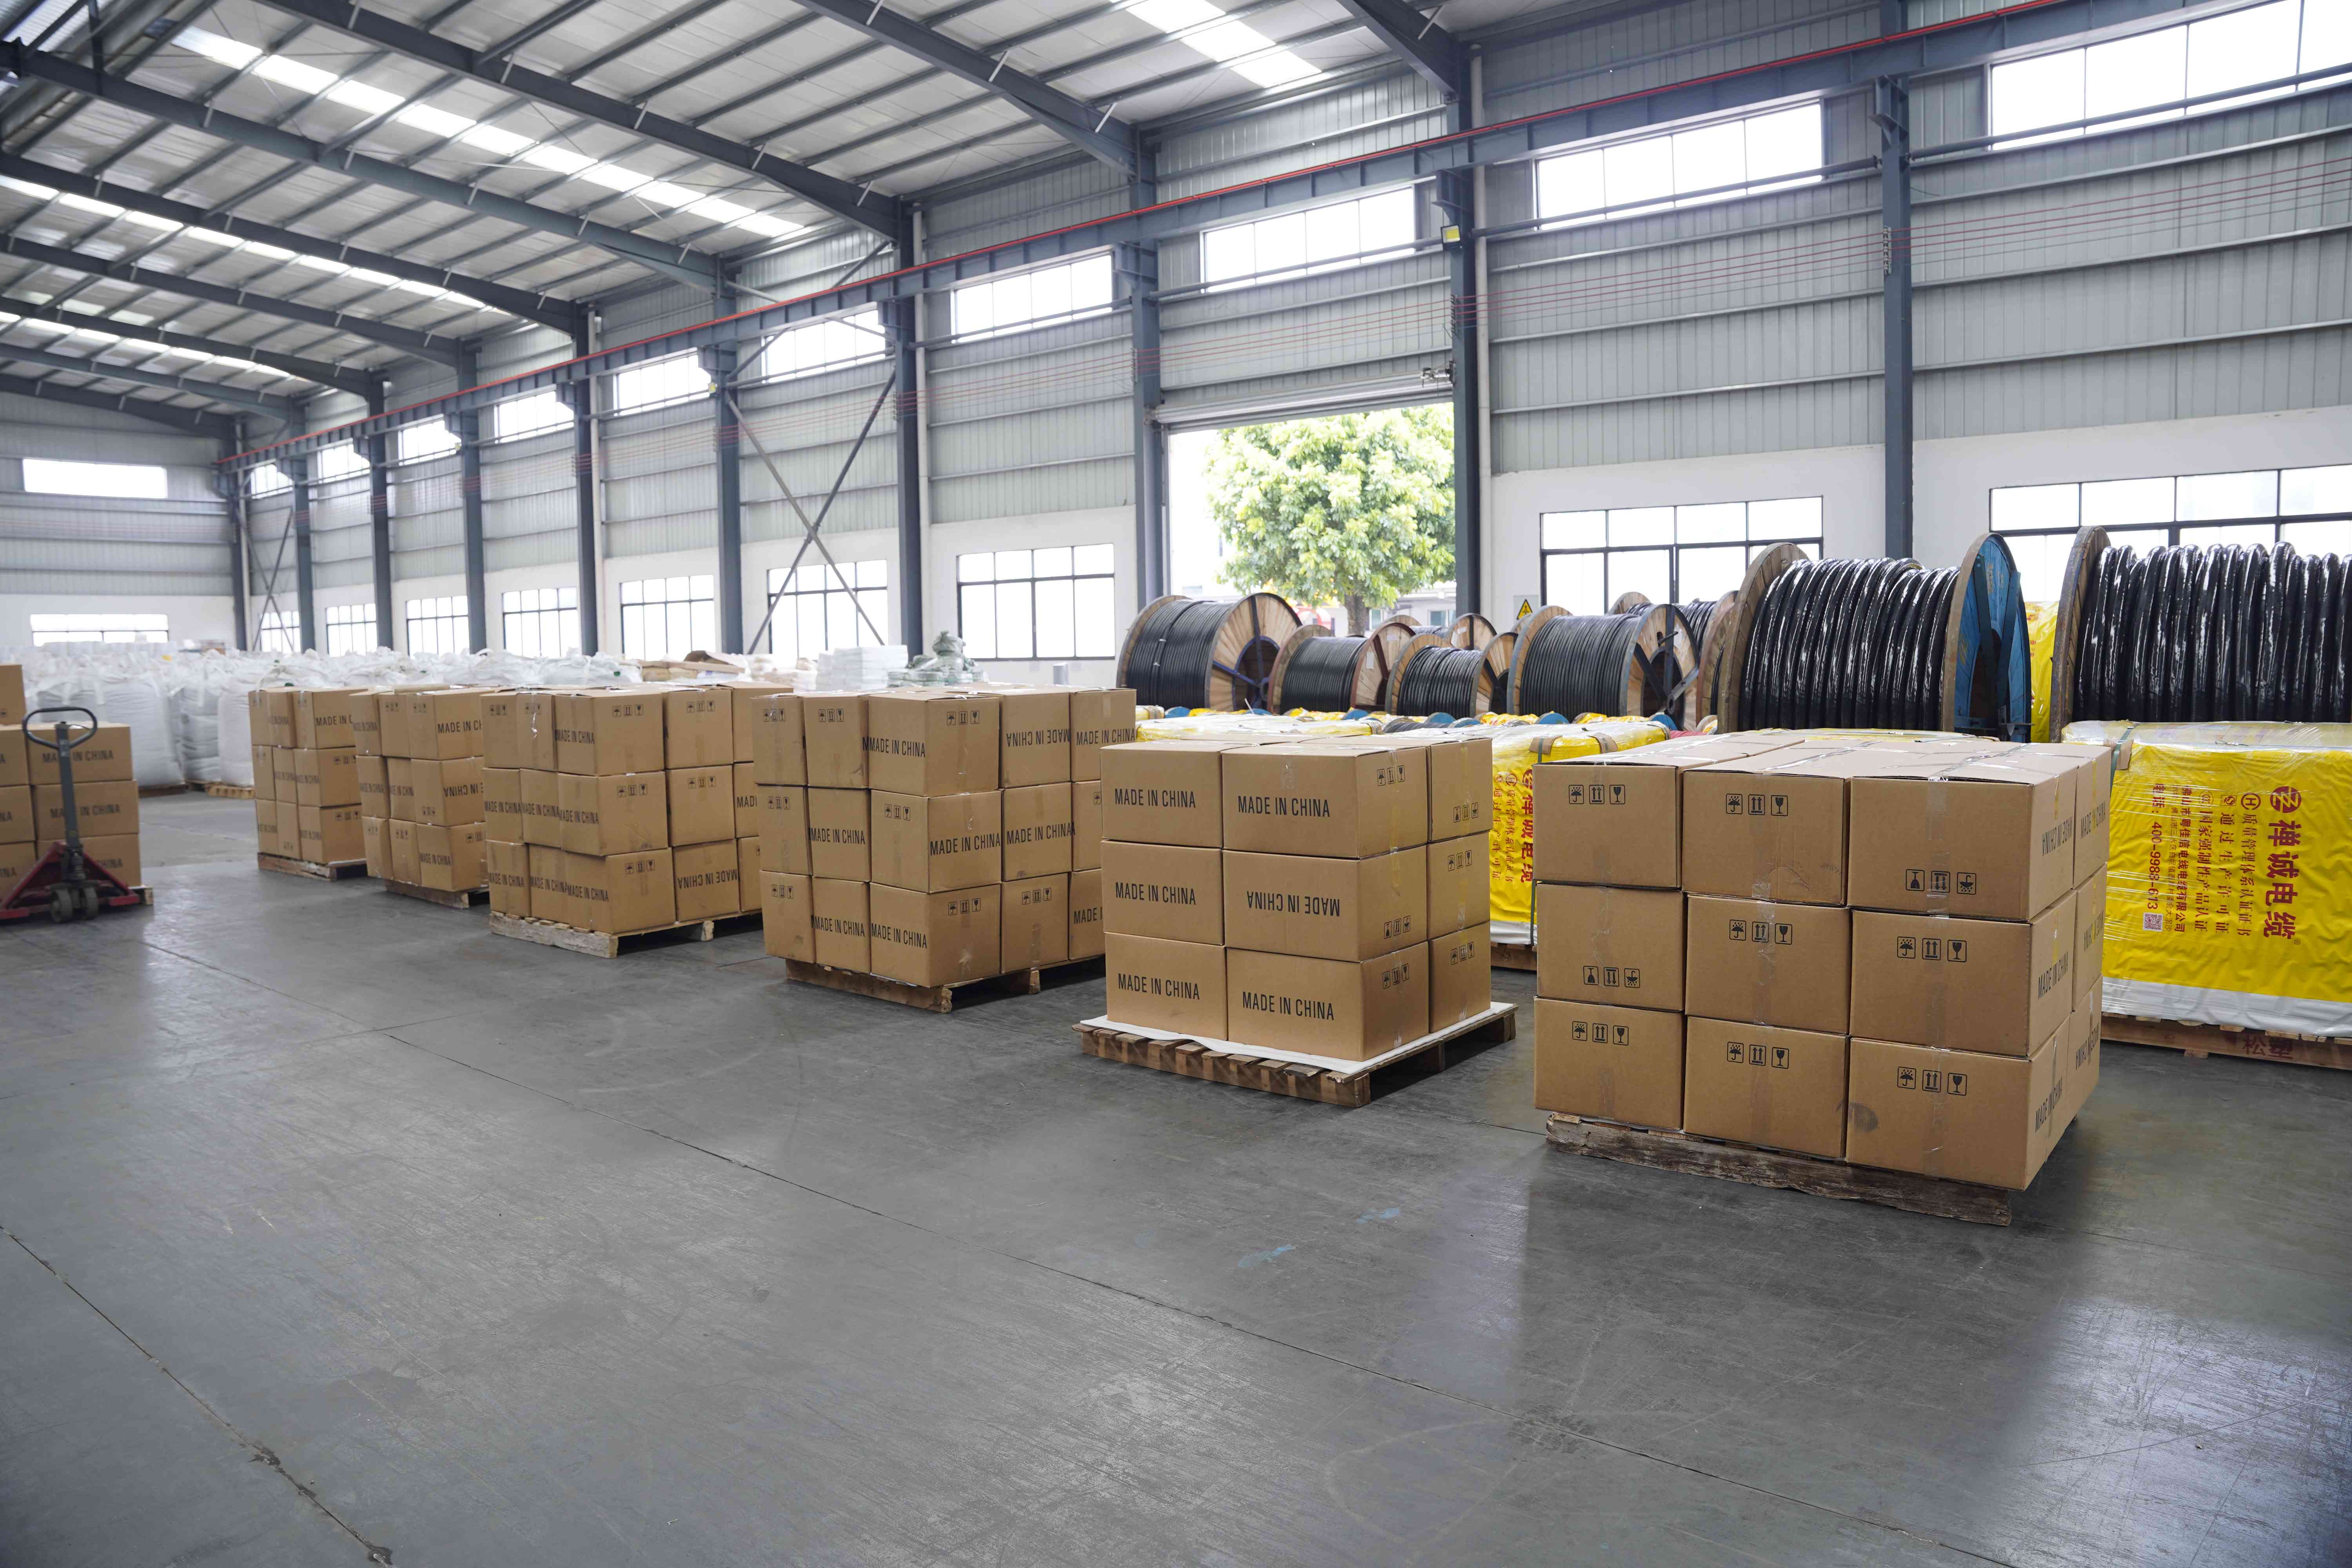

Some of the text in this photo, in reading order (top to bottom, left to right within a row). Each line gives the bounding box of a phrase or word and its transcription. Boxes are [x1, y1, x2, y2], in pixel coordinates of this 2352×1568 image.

[317, 715, 337, 726] MADE
[339, 715, 347, 724] IN
[437, 722, 461, 734] MADE
[463, 721, 471, 731] IN
[868, 737, 889, 753] MADE
[892, 739, 899, 755] IN
[902, 740, 926, 757] CHINA
[1006, 728, 1071, 747] MADE IN CHINA
[1076, 728, 1135, 746] MADE IN CHINA
[72, 751, 83, 762] IN
[85, 750, 114, 761] CHINA
[444, 785, 468, 797] CHINA
[470, 784, 478, 794] IN
[1114, 788, 1196, 808] MADE IN CHINA
[80, 806, 90, 816] IN
[92, 804, 120, 815] CHINA
[1238, 796, 1330, 817] MADE IN CHINA
[811, 828, 831, 842] MADE
[832, 829, 840, 843] IN
[842, 829, 866, 845] CHINA
[1007, 828, 1032, 845] MADE
[1035, 826, 1043, 840] IN
[1046, 823, 1071, 839] CHINA
[2062, 816, 2073, 844] MADE
[930, 832, 1001, 855] MADE IN CHINA
[2042, 827, 2057, 856] CHINA
[678, 869, 739, 889] MADE IN CHINA
[2216, 812, 2234, 933] 通过生产许可证
[2263, 819, 2302, 940] 禅诚电缆
[1116, 881, 1196, 905] MADE IN CHINA
[1247, 891, 1340, 916] MADE IN CHINA
[1074, 907, 1097, 924] MADE
[815, 916, 833, 932] MADE
[835, 919, 841, 933] IN
[843, 920, 865, 937] CHINA
[871, 923, 927, 949] MADE IN CHINA
[2038, 951, 2068, 1000] MADE IN CHINA
[1118, 973, 1200, 1000] MADE IN CHINA
[1242, 991, 1334, 1020] MADE IN CHINA
[2035, 1076, 2062, 1133] MADE IN CHINA
